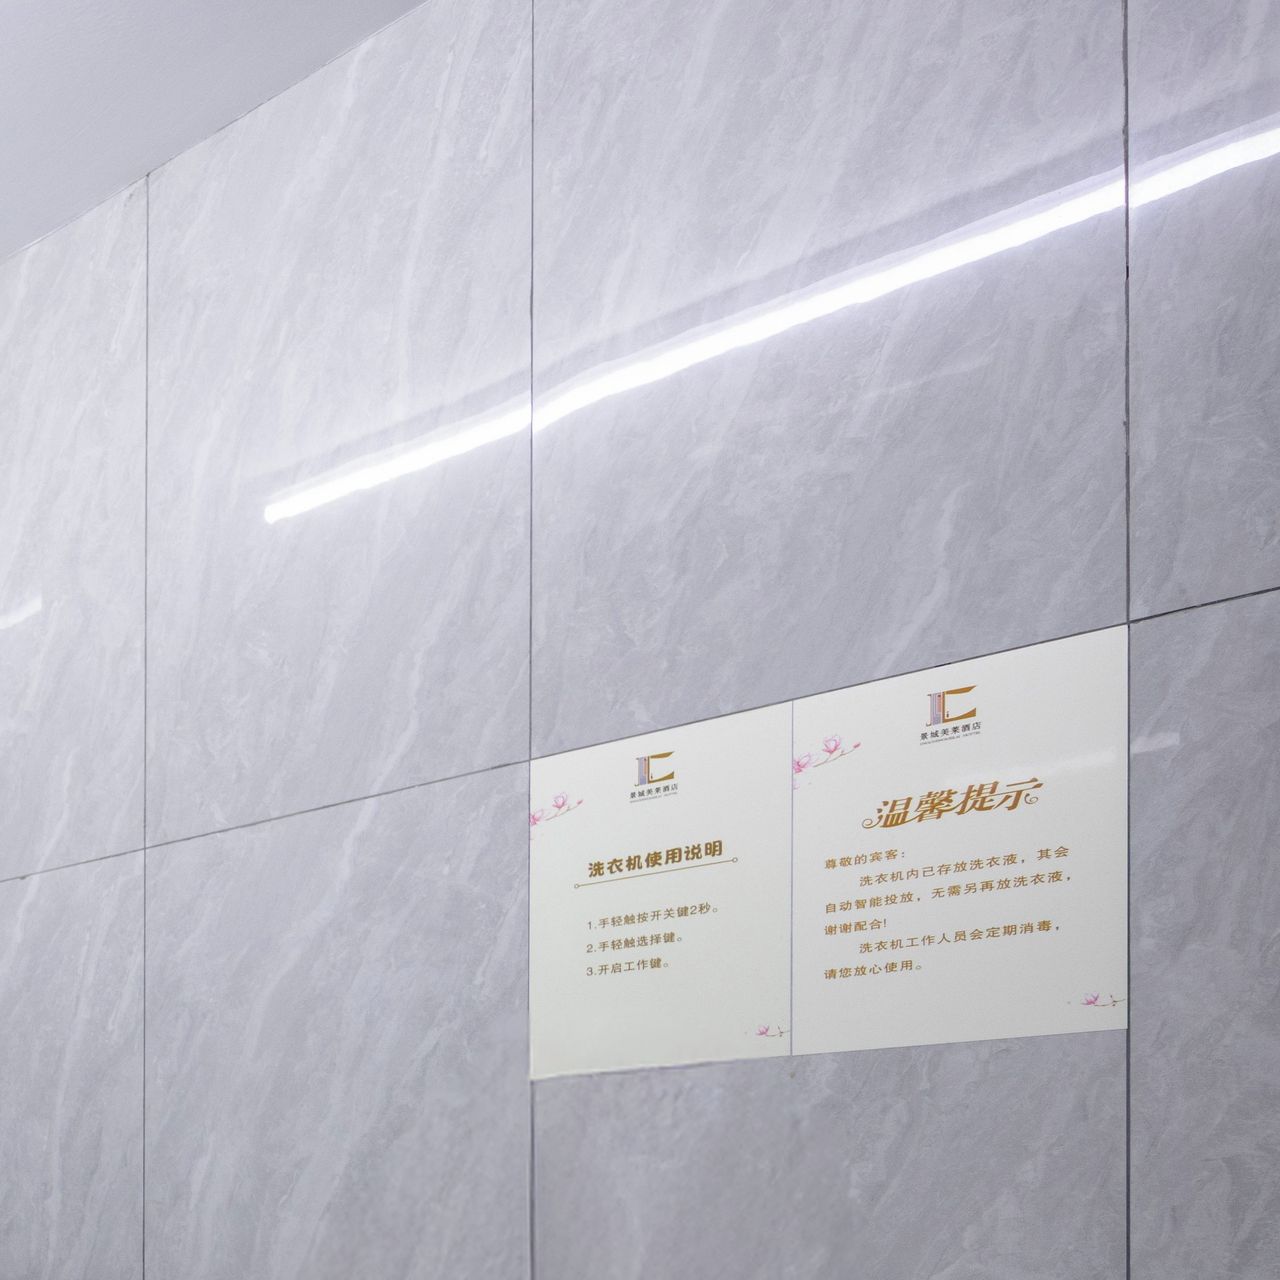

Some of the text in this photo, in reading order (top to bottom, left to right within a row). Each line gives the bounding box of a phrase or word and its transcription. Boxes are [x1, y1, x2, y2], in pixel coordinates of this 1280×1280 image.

[862, 777, 1044, 829] 温馨提示
[588, 839, 724, 878] 洗衣机使用说明
[824, 848, 906, 870] 尊敬的宾客：
[588, 902, 719, 930] 1.手轻触按开关键2秒。
[824, 918, 887, 936] 谢谢配合!
[586, 931, 682, 954] 2.手轻触选择键。
[859, 919, 1061, 954] 洗衣机工作人员会定期消毒，
[586, 957, 669, 977] 3.开启工作键。
[824, 959, 923, 980] 请您放心使用。
